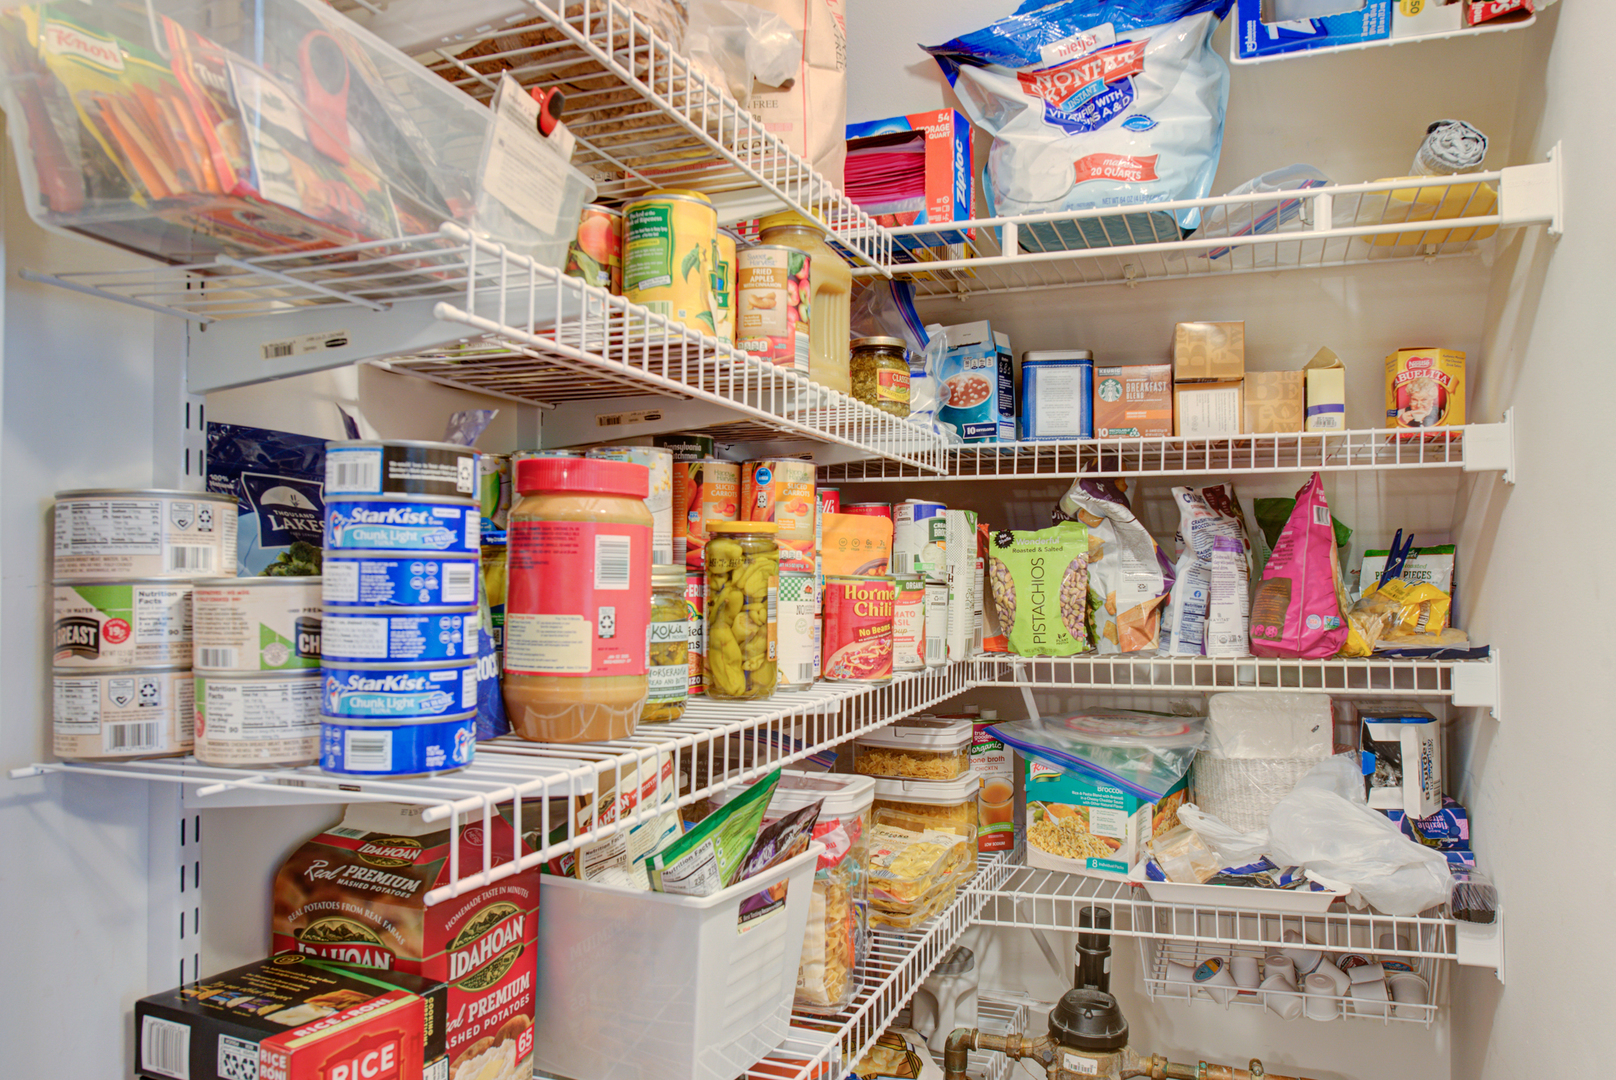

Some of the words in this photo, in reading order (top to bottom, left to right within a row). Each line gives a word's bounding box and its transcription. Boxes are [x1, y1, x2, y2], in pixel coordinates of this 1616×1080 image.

[48, 28, 120, 64] Knorr
[1058, 34, 1098, 57] meijer
[1033, 51, 1136, 90] NONFAT
[753, 100, 779, 109] FREE
[1068, 84, 1098, 110] INSTANT
[1096, 89, 1124, 107] WITH
[937, 112, 950, 123] 54
[929, 131, 951, 140] QUART
[955, 138, 967, 209] Ziploc
[1091, 168, 1102, 176] 20
[1104, 168, 1142, 180] QUARTS
[752, 268, 772, 276] FRIED
[1394, 369, 1448, 387] ABUELITA
[1125, 381, 1167, 393] BREAKFAST
[1125, 392, 1145, 400] BLEND
[966, 426, 976, 435] 10
[1097, 428, 1109, 438] 10
[711, 490, 738, 498] CARROTS
[783, 489, 810, 497] CARROTS
[272, 509, 316, 519] THOUSAND
[351, 506, 429, 525] StarKist
[352, 530, 388, 541] Chunk
[389, 530, 418, 544] Light
[1016, 536, 1060, 546] Wonderful
[1012, 546, 1036, 554] Roasted
[1403, 570, 1432, 580] PIECES
[844, 584, 895, 601] Horme
[905, 581, 924, 590] ORGANIC
[1030, 556, 1046, 644] PISTACHIOS
[854, 601, 892, 617] Chili
[894, 610, 916, 618] MATO
[858, 628, 871, 637] No
[872, 623, 891, 636] Beans
[894, 627, 908, 636] oup
[347, 674, 427, 692] StarKist
[349, 697, 385, 709] Chunk
[386, 697, 415, 711] Light
[971, 740, 1003, 755] organic
[1418, 821, 1449, 830] flexible
[357, 843, 422, 861] IDAHOAN
[585, 841, 611, 856] Nutrition
[662, 855, 694, 876] Nutrition
[694, 840, 712, 855] Facts
[1091, 858, 1098, 868] 8
[304, 859, 347, 881] Real
[342, 864, 422, 893] PREMIUM
[336, 878, 369, 890] MASHED
[370, 884, 412, 899] POTATOES
[445, 894, 481, 931] HOMEMADE
[481, 887, 498, 900] TASTE
[499, 886, 507, 894] IN
[507, 885, 530, 899] MINUTES
[287, 908, 304, 923] REAL
[304, 901, 340, 913] POTATOES
[341, 902, 363, 915] FROM
[364, 909, 382, 925] REAL
[382, 919, 406, 946] FARMS
[449, 915, 525, 981] IDAHOAN
[446, 1003, 466, 1033] eal
[468, 970, 531, 1024] PREMIUM
[293, 1015, 341, 1037] RICE
[446, 1024, 480, 1049] ASHED
[484, 993, 530, 1030] POTATOES
[518, 1027, 533, 1053] 65
[259, 1048, 287, 1069] RICE
[331, 1042, 395, 1080] RICE
